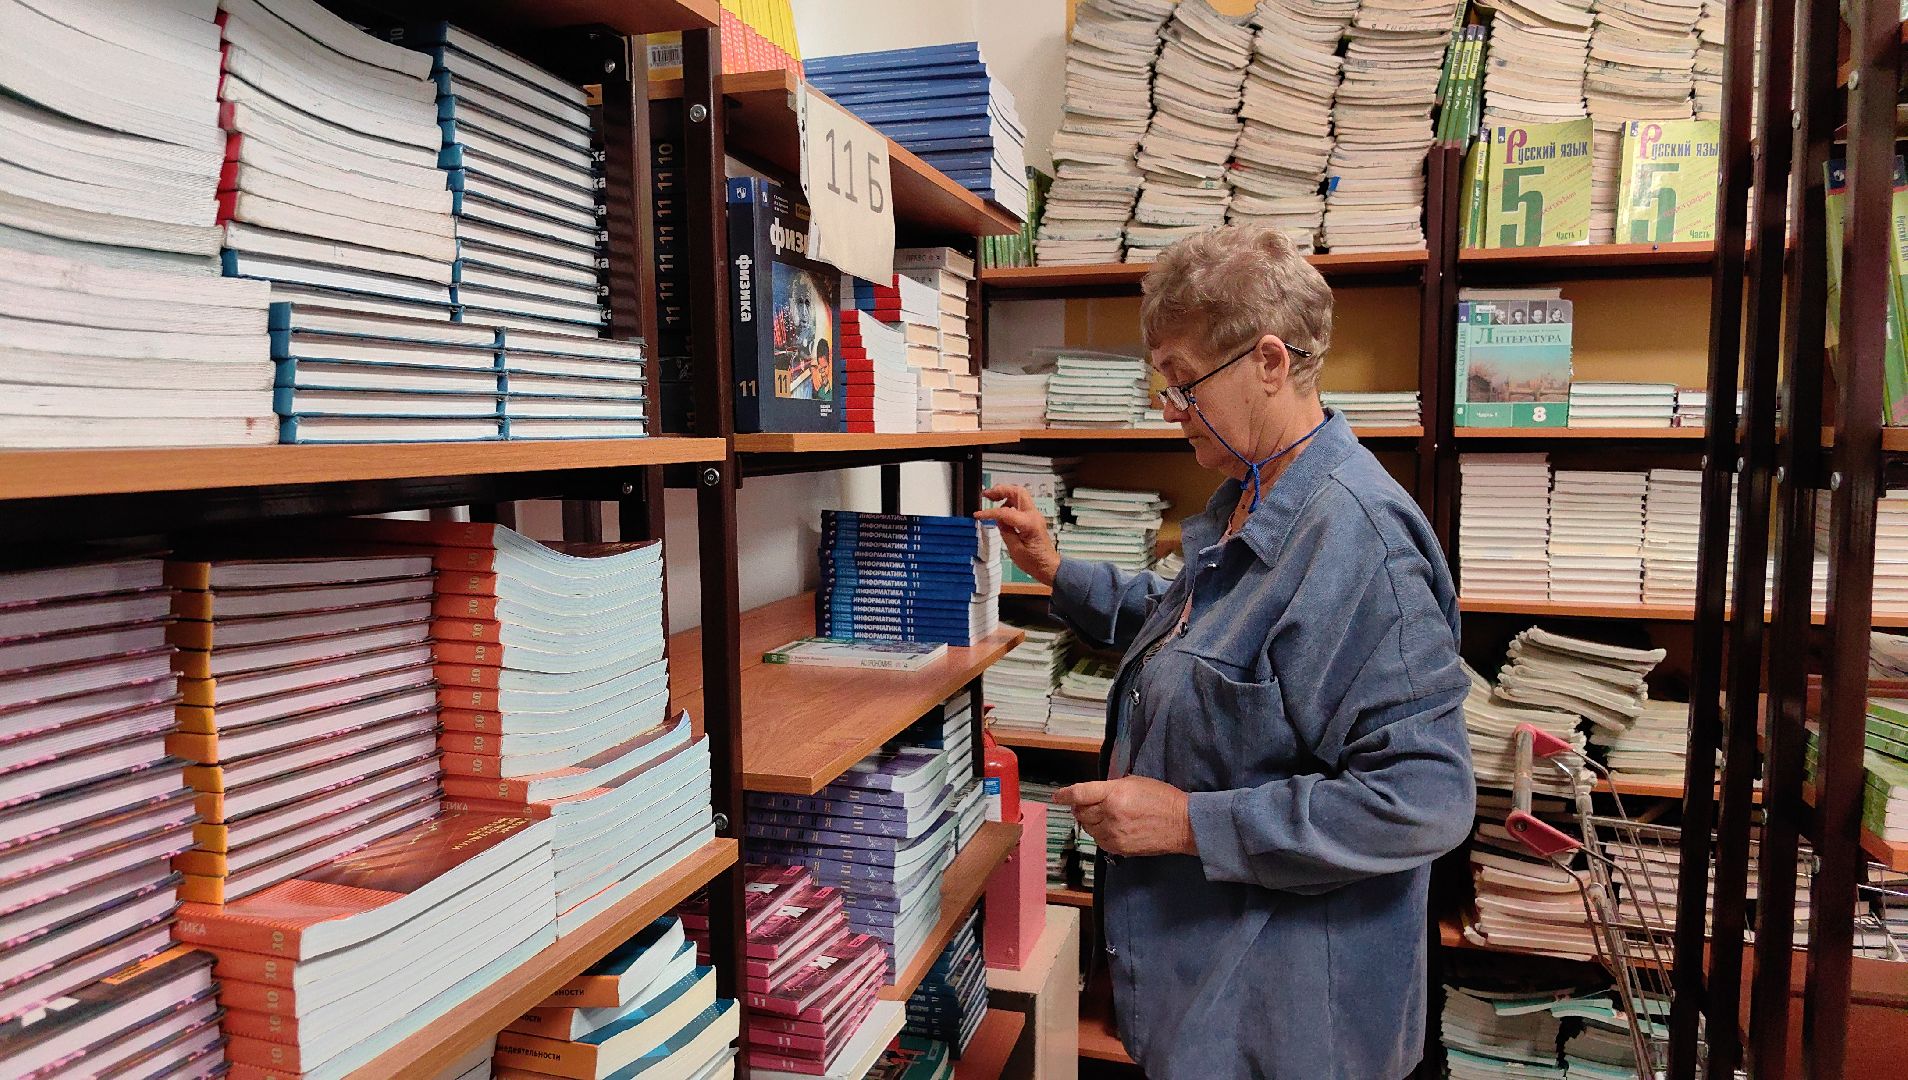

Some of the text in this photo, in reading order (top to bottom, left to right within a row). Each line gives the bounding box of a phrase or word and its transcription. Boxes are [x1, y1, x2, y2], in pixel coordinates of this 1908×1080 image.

[1503, 129, 1588, 165] Русский язык
[1640, 123, 1719, 160] Русский язы
[658, 143, 673, 165] 10
[826, 128, 884, 214] 11 Б
[657, 172, 673, 192] 11
[657, 200, 672, 218] 11
[1499, 165, 1545, 248] 5
[1630, 162, 1680, 243] 5
[659, 226, 674, 245] 11
[1555, 230, 1575, 241] Часть
[1689, 229, 1710, 239] Часть
[659, 254, 674, 273] 11
[659, 282, 674, 300] 11
[735, 254, 753, 323] физика
[665, 306, 680, 325] 11
[739, 380, 757, 398] 11
[777, 373, 788, 394] 11
[1532, 406, 1547, 423] 8
[859, 531, 909, 540] ИНФОРМАТИКА
[858, 541, 908, 550] ИНФОРМАТИКА
[856, 561, 905, 569] ИНФОРМАТИКА
[858, 569, 907, 578] ИНФОРМАТИКА
[859, 578, 907, 587] ИНФОРМАТИКА
[855, 588, 904, 597] ИНФОРМАТИКА
[468, 599, 479, 614] 10
[853, 597, 901, 605] ИНФОРМАТИКА
[853, 606, 901, 614] ИНФОРМАТИКА
[853, 615, 902, 623] ИНФОРМАТИКА
[472, 623, 484, 638] 10
[853, 623, 902, 632] ИНФОРМАТИКА
[854, 632, 903, 640] ИНФОРМАТИКА
[475, 646, 486, 661] 10
[471, 668, 481, 683] 10
[472, 691, 482, 706] 10
[474, 714, 485, 729] 10
[474, 736, 484, 751] 10
[472, 759, 483, 774] 10
[498, 783, 509, 797] 10
[272, 930, 285, 951] 10
[265, 960, 277, 980] 10
[753, 997, 766, 1007] 11
[778, 1036, 791, 1046] 11
